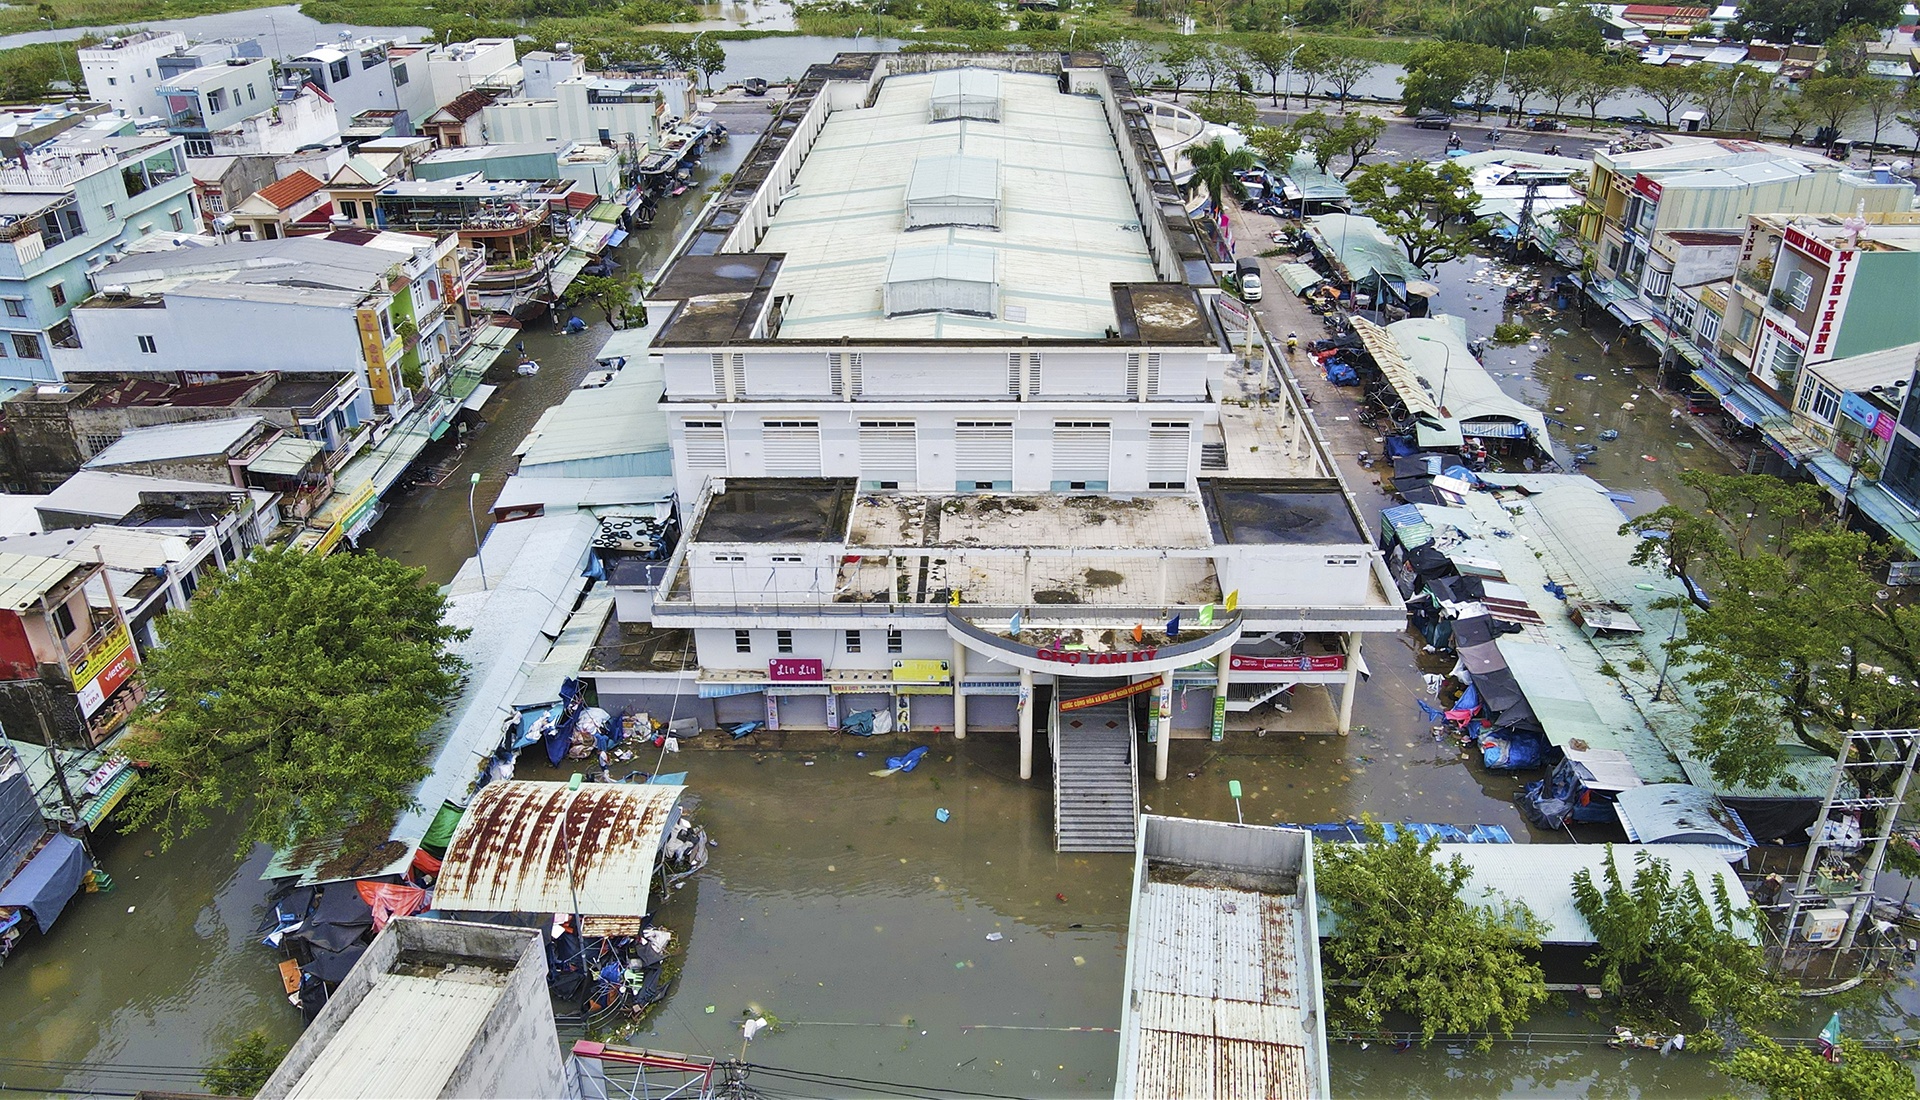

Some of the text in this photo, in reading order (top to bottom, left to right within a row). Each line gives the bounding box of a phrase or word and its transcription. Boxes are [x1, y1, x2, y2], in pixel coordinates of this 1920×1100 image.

[1813, 251, 1854, 354] MINH THANH
[1773, 324, 1806, 351] Minh Thanh
[92, 626, 124, 658] KIM
[104, 656, 127, 681] viettel
[777, 664, 816, 676] Lin Lin
[1087, 652, 1127, 664] TAM
